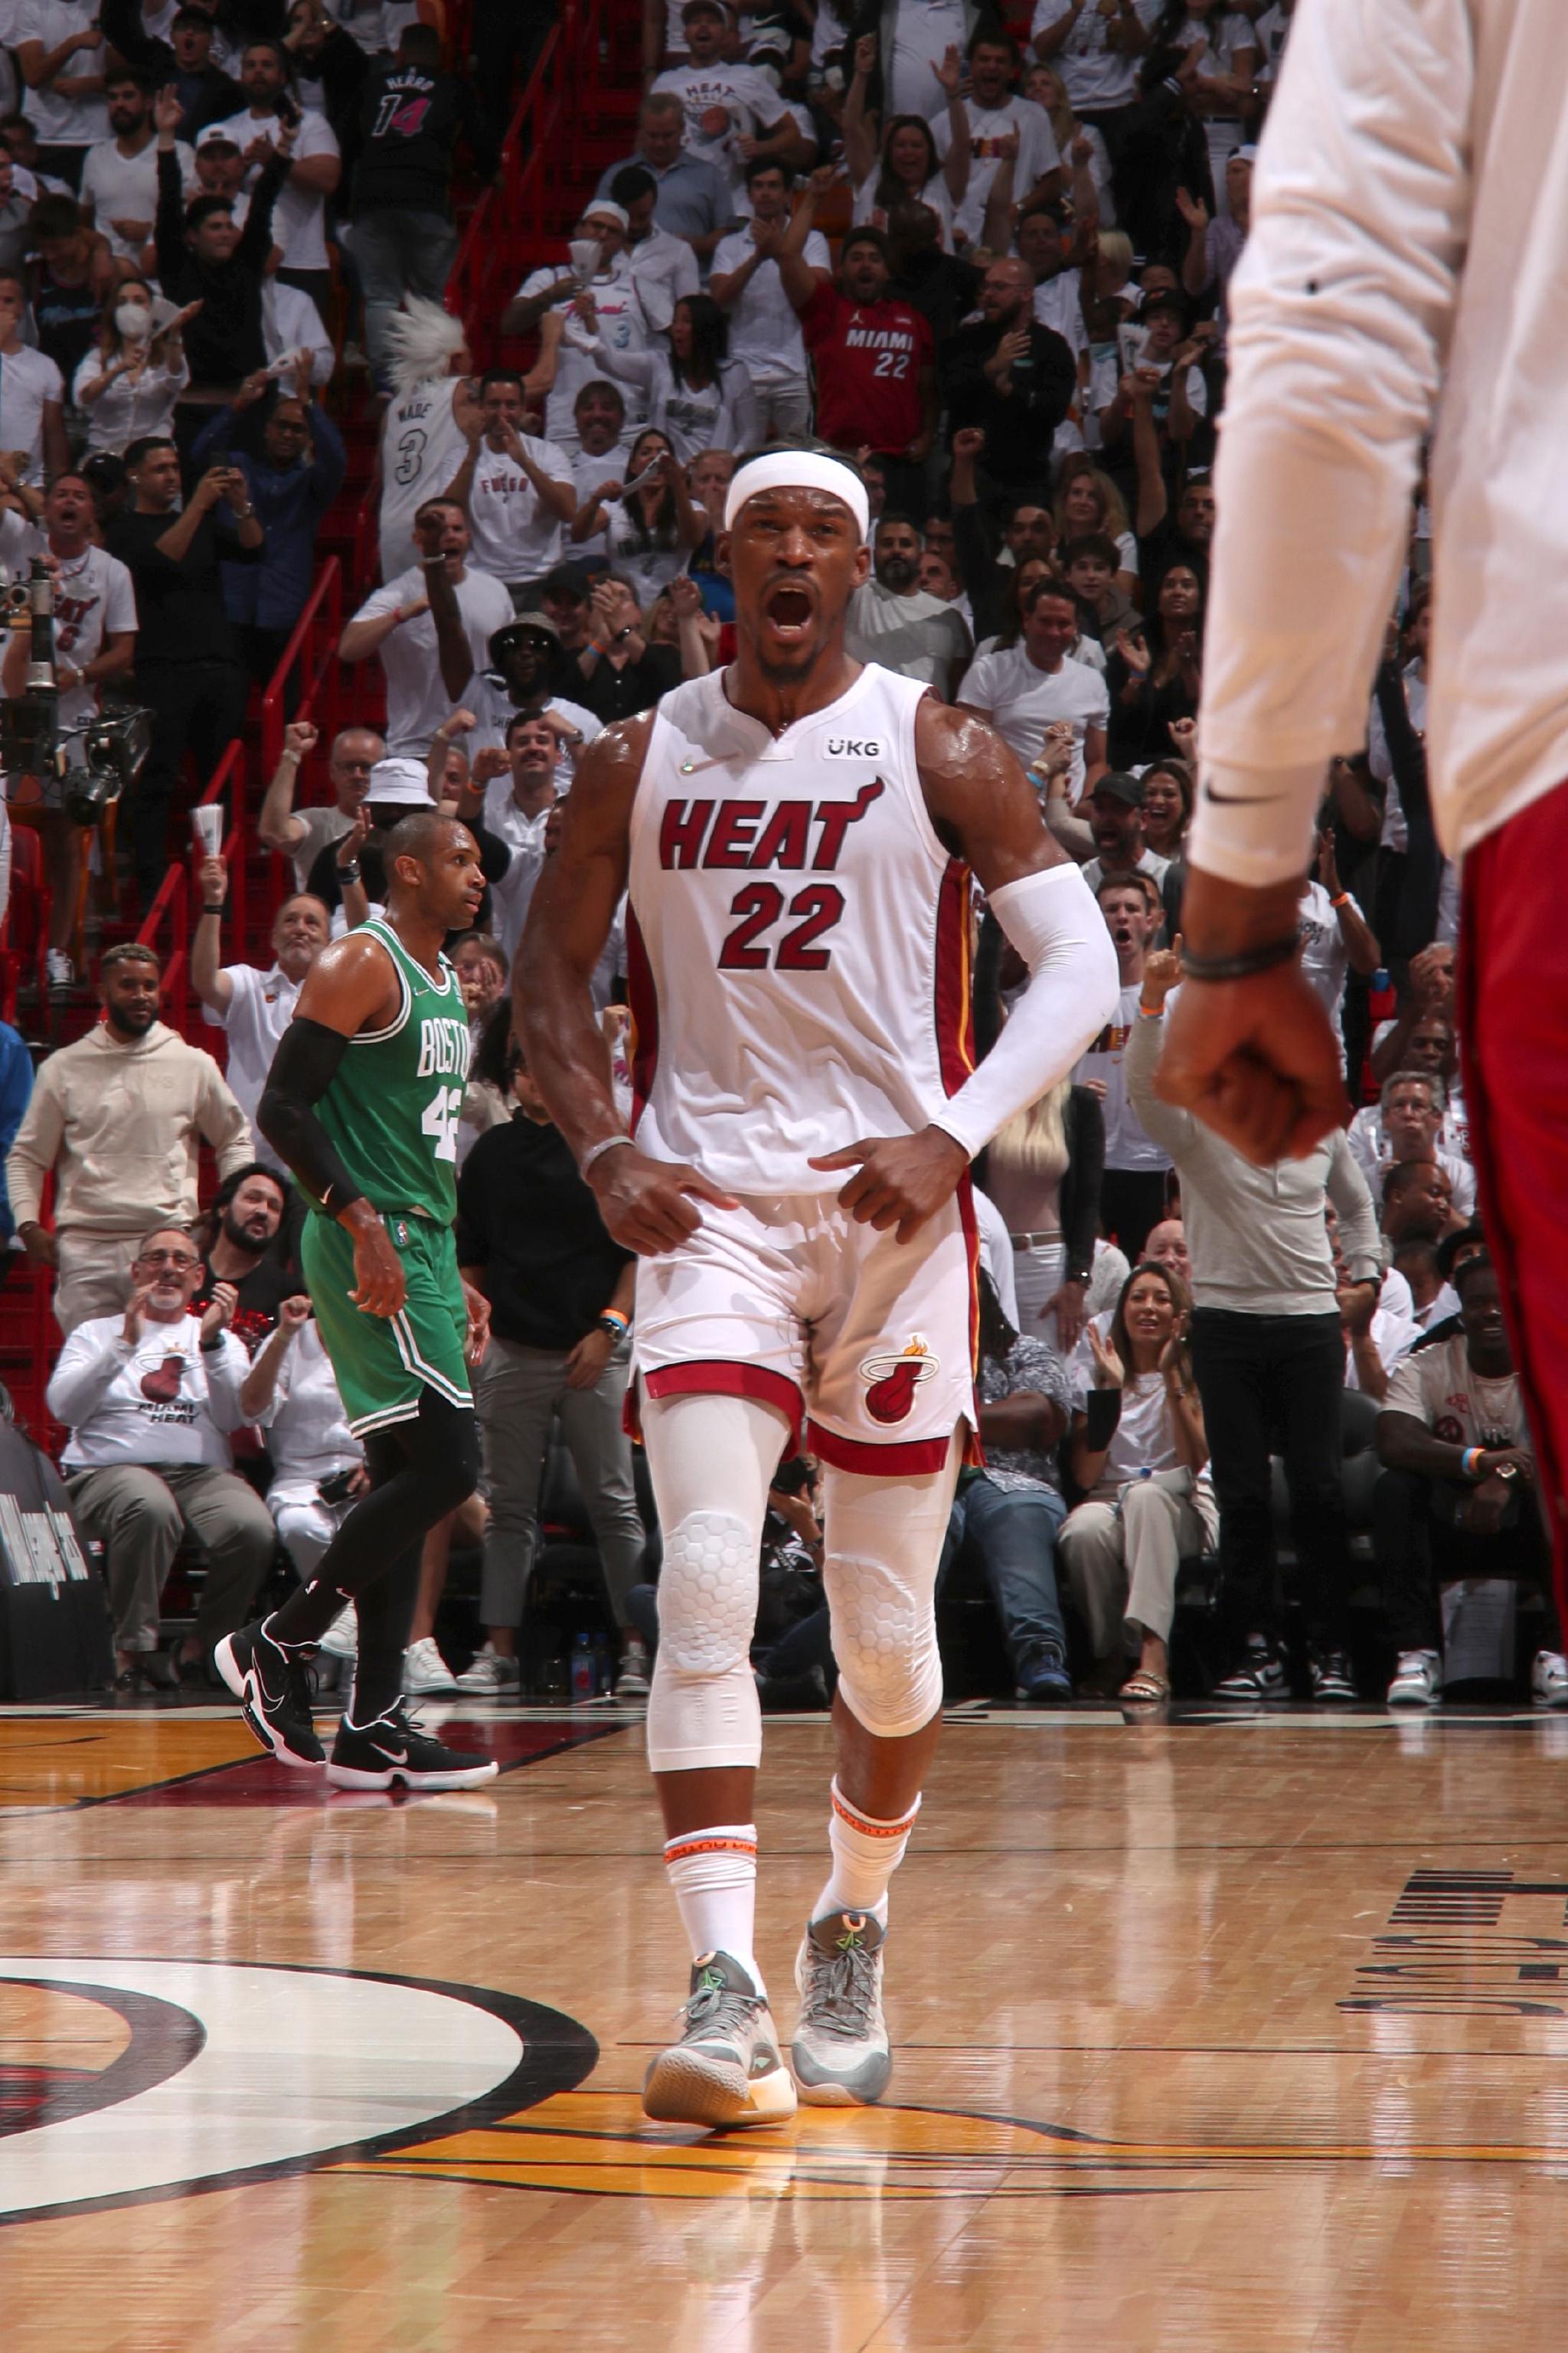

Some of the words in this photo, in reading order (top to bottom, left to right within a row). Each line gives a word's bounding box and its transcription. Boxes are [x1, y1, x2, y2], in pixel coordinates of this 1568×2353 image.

[385, 74, 436, 91] HERRO
[686, 82, 736, 97] HEAT
[371, 93, 433, 137] 14
[612, 322, 630, 348] 3
[845, 328, 913, 351] MIAMI
[874, 351, 911, 380] 22
[397, 403, 433, 423] WADE
[395, 427, 429, 485] 3
[659, 775, 886, 871] HEAT
[717, 881, 847, 971] 22
[416, 1016, 472, 1082] BOSTO
[139, 1403, 194, 1413] MIAMI
[151, 1413, 200, 1424] HEAT
